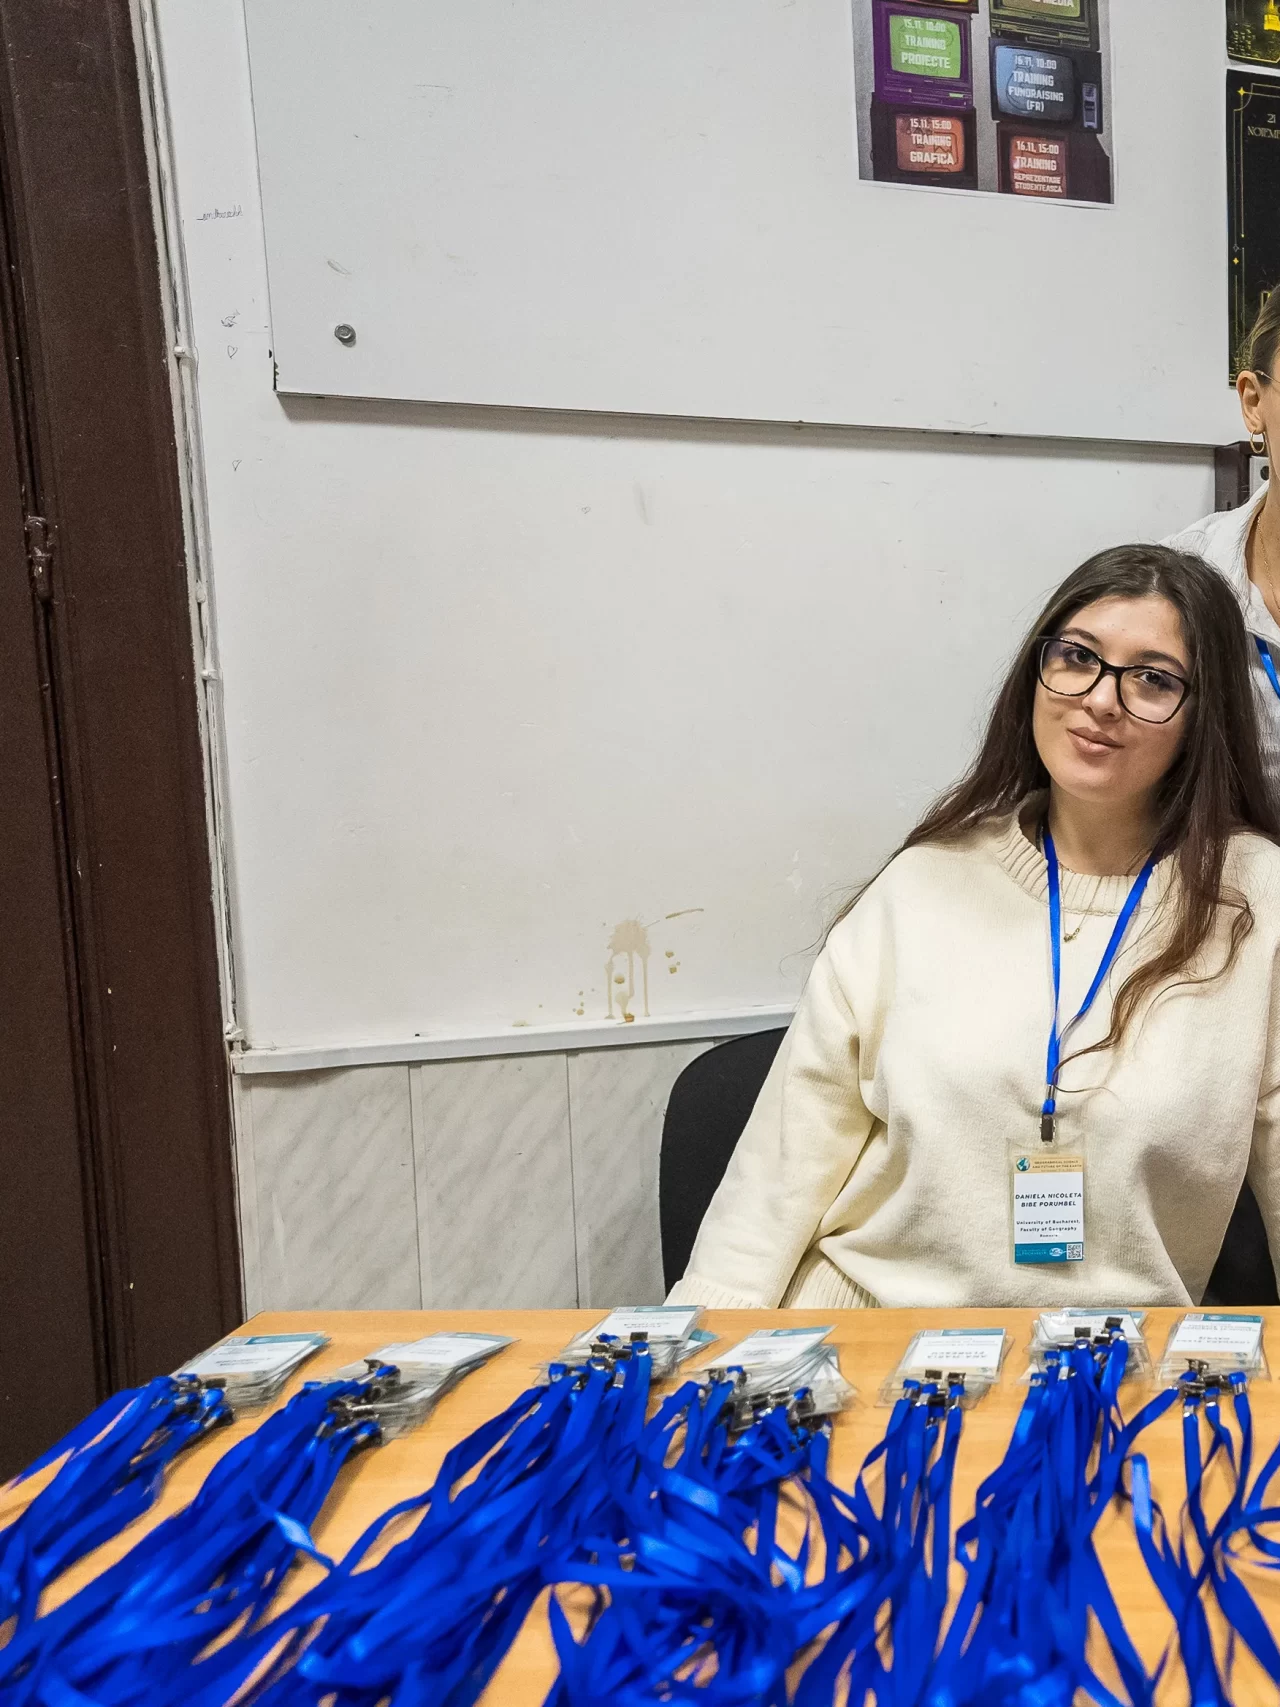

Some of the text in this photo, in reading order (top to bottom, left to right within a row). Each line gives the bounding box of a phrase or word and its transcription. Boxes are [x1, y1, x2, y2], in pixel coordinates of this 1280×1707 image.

[905, 34, 946, 50] TRAINING
[901, 52, 951, 69] PROIECTE
[1012, 70, 1054, 87] TRAINING
[1008, 85, 1064, 102] FUNDRAISING
[1026, 100, 1045, 112] (FR)
[931, 119, 952, 130] 15:00
[1266, 113, 1277, 124] 21
[911, 133, 952, 147] TRAINING
[1038, 143, 1060, 155] 15:00
[909, 150, 955, 165] GRAFICA
[1014, 155, 1057, 171] TRAINING
